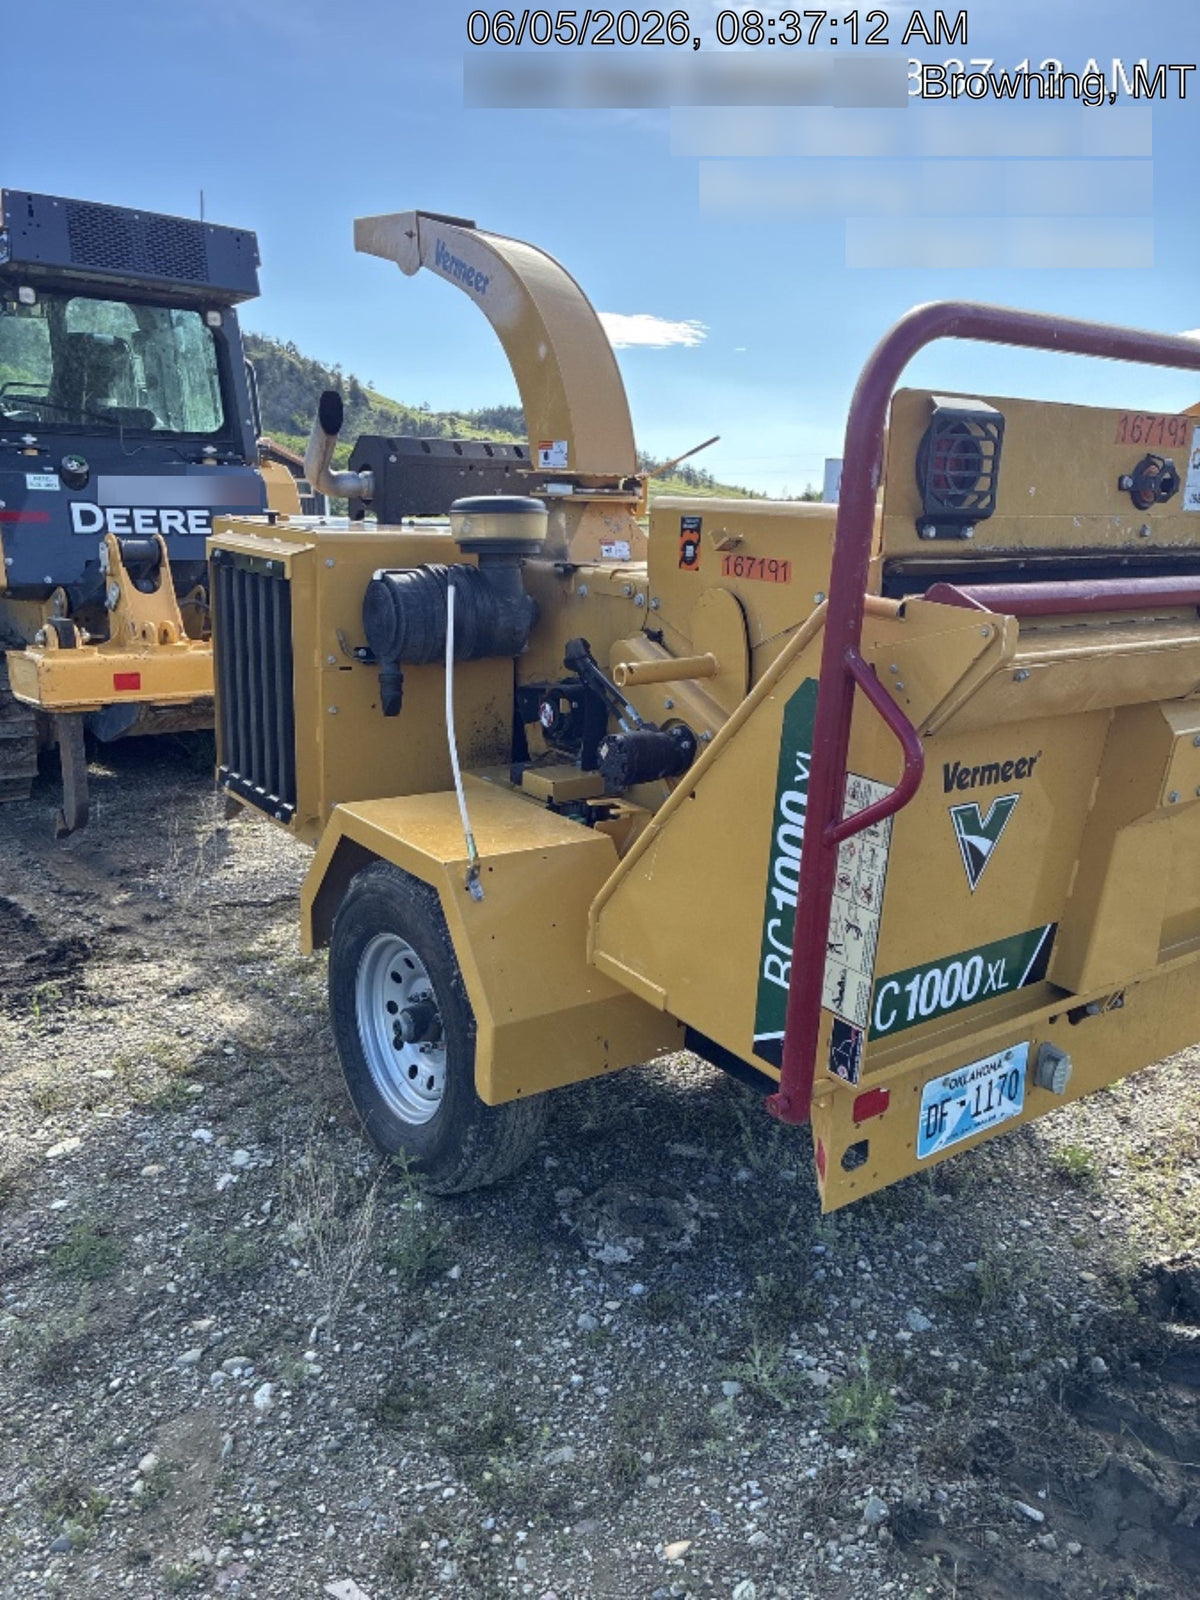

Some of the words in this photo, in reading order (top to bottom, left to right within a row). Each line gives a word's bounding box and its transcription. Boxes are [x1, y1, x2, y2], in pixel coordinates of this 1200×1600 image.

[435, 237, 490, 296] Vermeer
[1121, 415, 1188, 447] 167191
[70, 502, 213, 534] DEERE
[725, 554, 789, 582] 167191
[943, 756, 1038, 793] Vermeer
[948, 1059, 1004, 1091] OKLAHOMA
